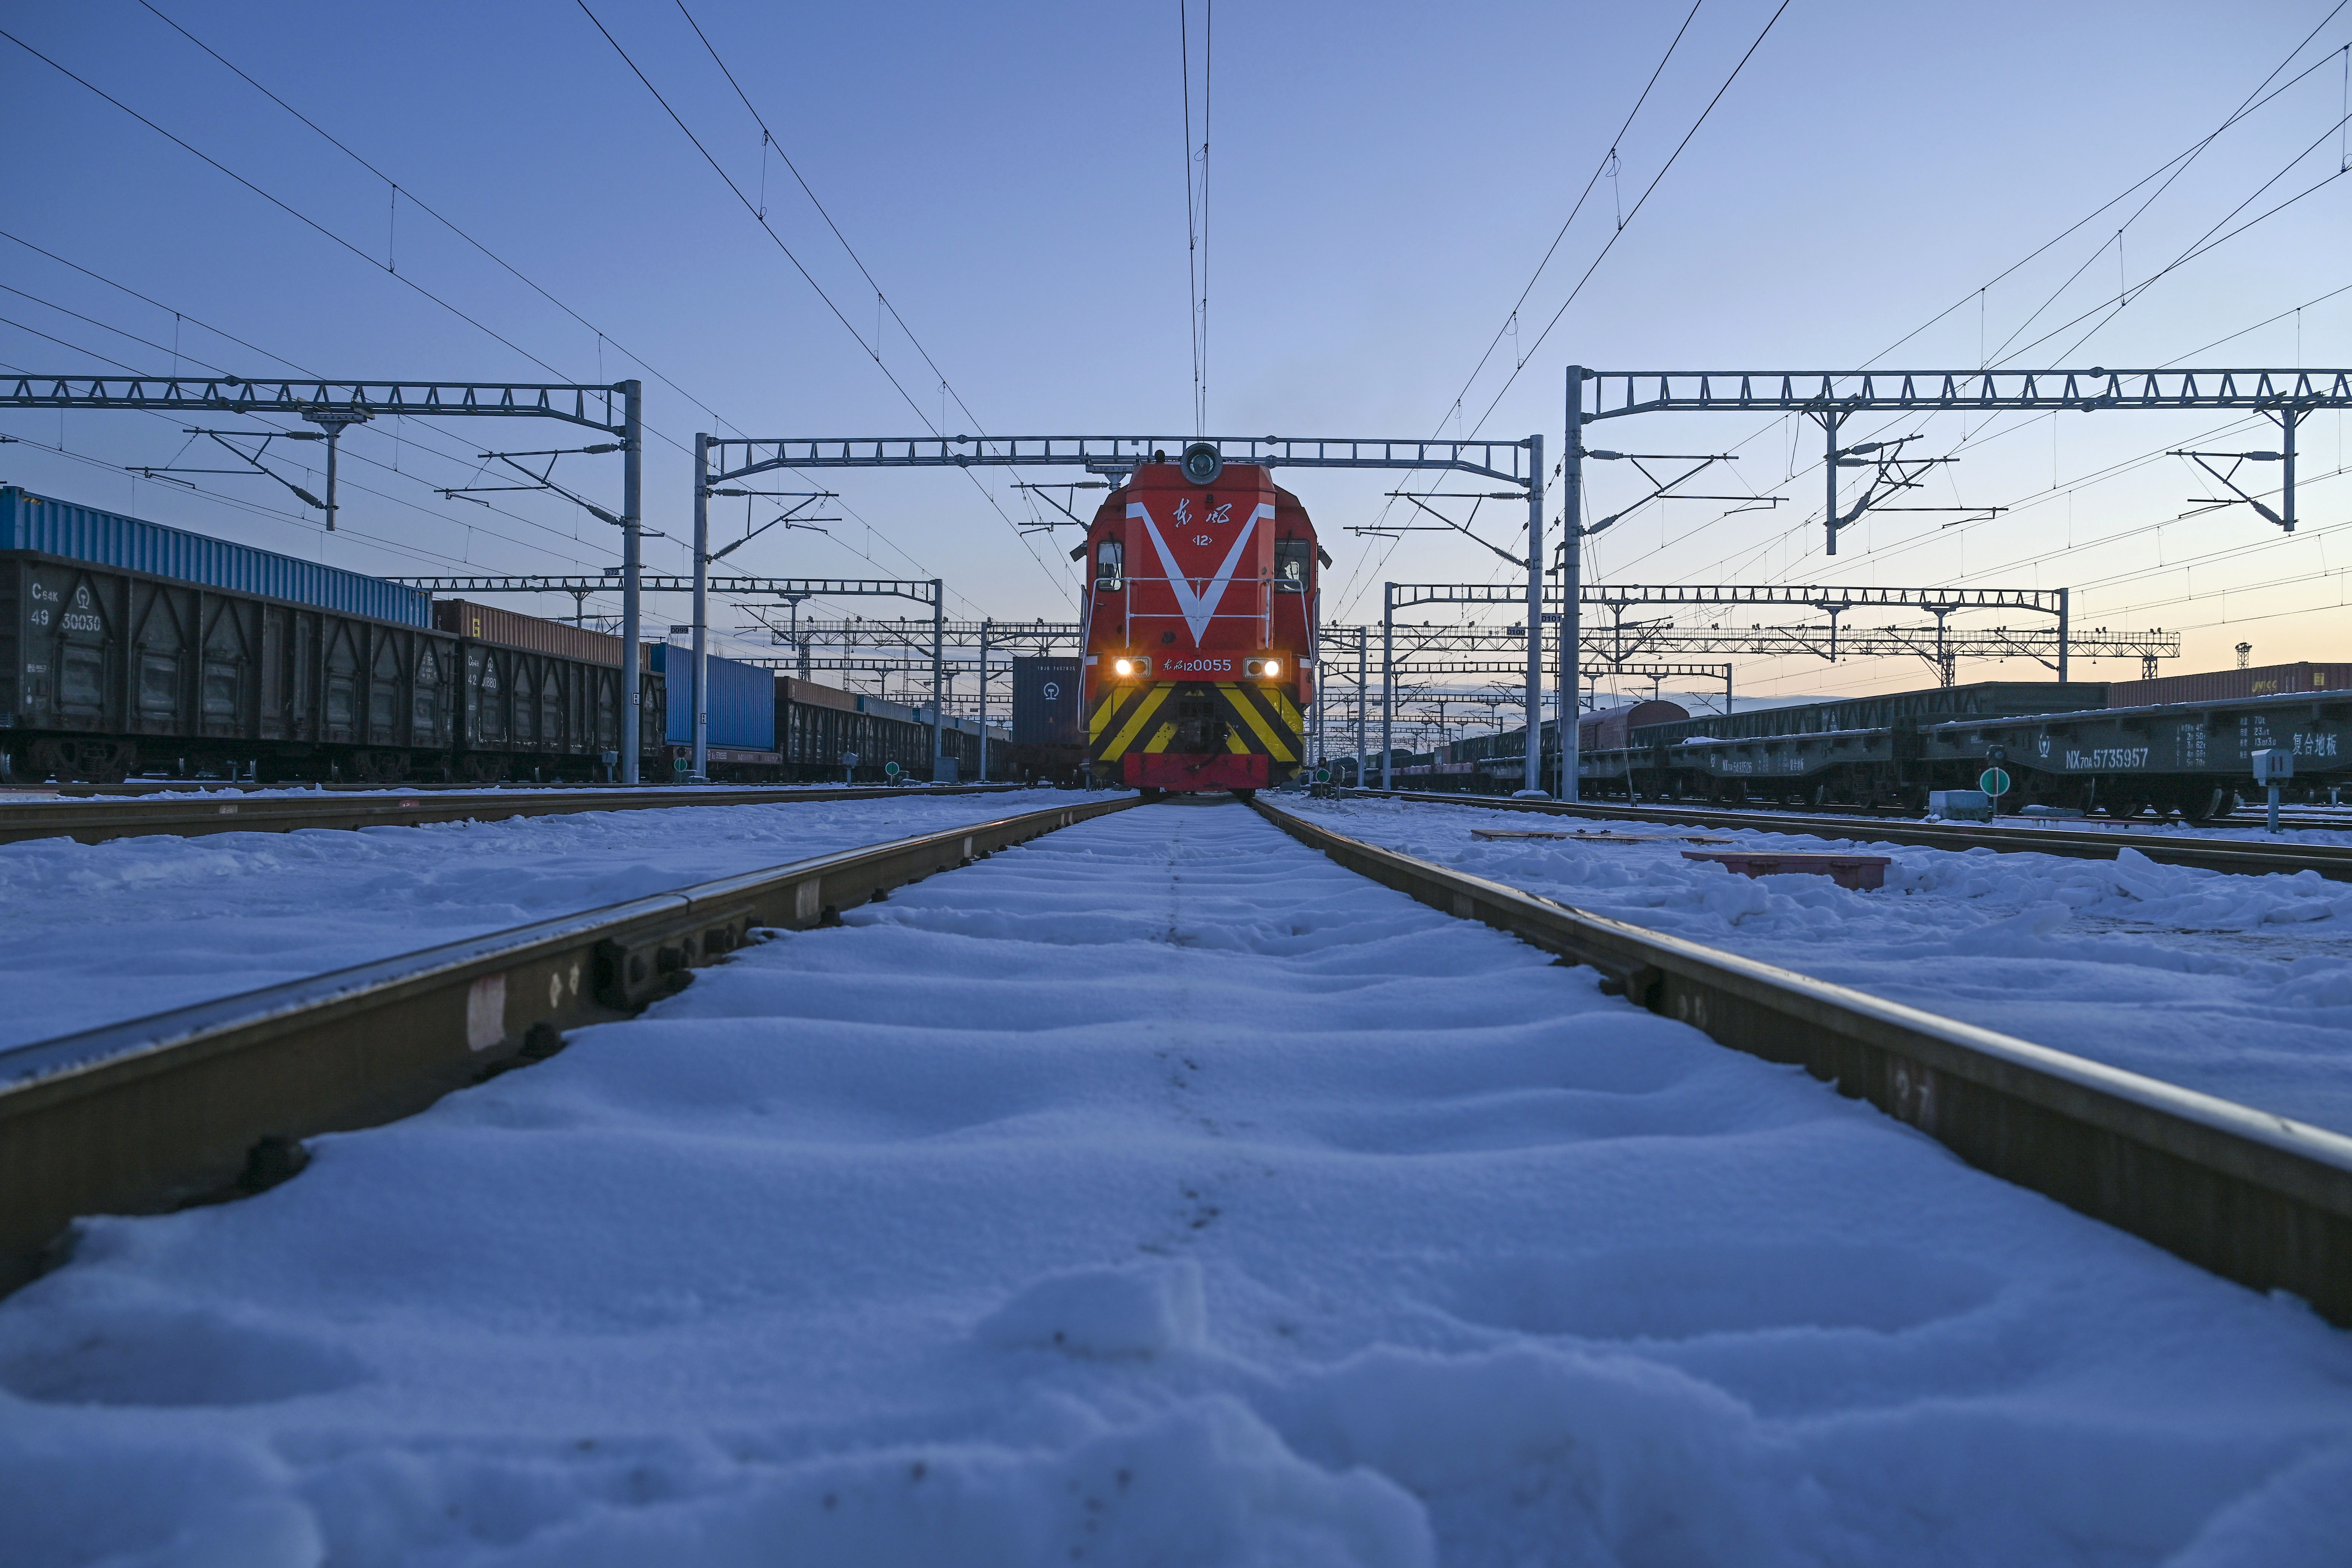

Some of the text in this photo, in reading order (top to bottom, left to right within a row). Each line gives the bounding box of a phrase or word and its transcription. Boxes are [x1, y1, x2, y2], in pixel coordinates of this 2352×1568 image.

[32, 583, 58, 602] C64K
[31, 609, 100, 631] 49 30030
[2292, 733, 2337, 756] 复合地板
[2094, 748, 2148, 768] 5735957
